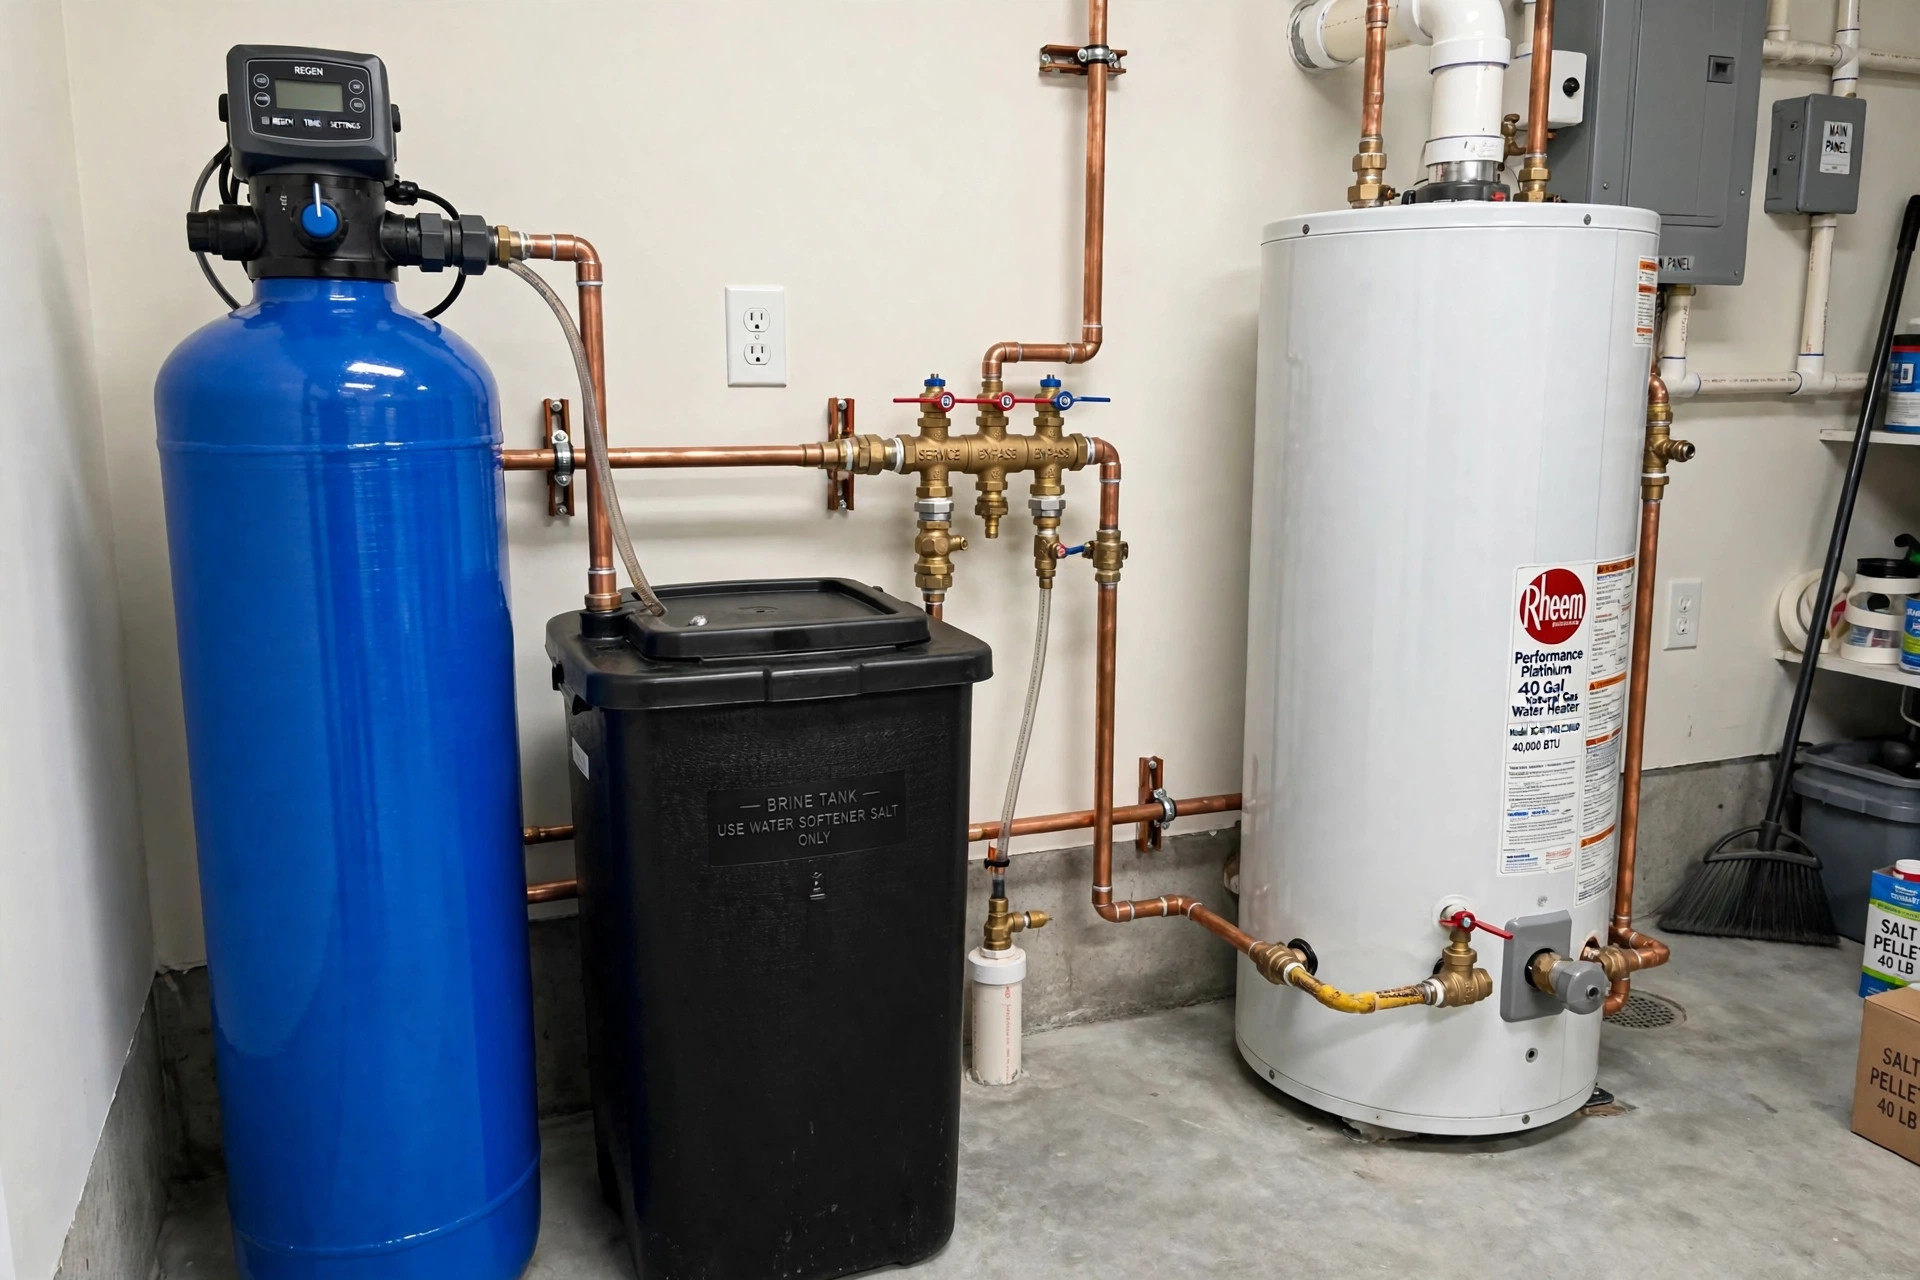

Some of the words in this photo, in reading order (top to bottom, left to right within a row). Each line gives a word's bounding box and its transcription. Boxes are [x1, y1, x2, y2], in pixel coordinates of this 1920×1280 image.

[294, 66, 324, 76] REGEN
[329, 120, 361, 130] SETTINGS
[1829, 124, 1848, 137] MAIN
[1523, 573, 1584, 631] Rheem
[1515, 649, 1584, 665] Performance
[1518, 680, 1540, 696] 40
[1543, 678, 1565, 694] Gal
[1511, 704, 1544, 718] Water
[1547, 702, 1581, 716] Heater
[1512, 741, 1541, 755] 40,000
[1543, 738, 1561, 750] BTU
[767, 794, 813, 813] BRINE
[819, 789, 858, 807] TANK
[717, 823, 745, 837] USE
[750, 817, 794, 834] WATER
[799, 809, 867, 829] SOFTENER
[870, 804, 899, 820] SALT
[798, 831, 831, 847] ONLY
[1881, 918, 1918, 942] SALT
[1873, 933, 1920, 961] PELLE
[1877, 954, 1894, 969] 40
[1898, 959, 1914, 975] LB
[1882, 1047, 1920, 1078] SALT
[1870, 1066, 1920, 1105] PELLE
[1877, 1097, 1895, 1118] 40
[1899, 1105, 1918, 1130] LB
